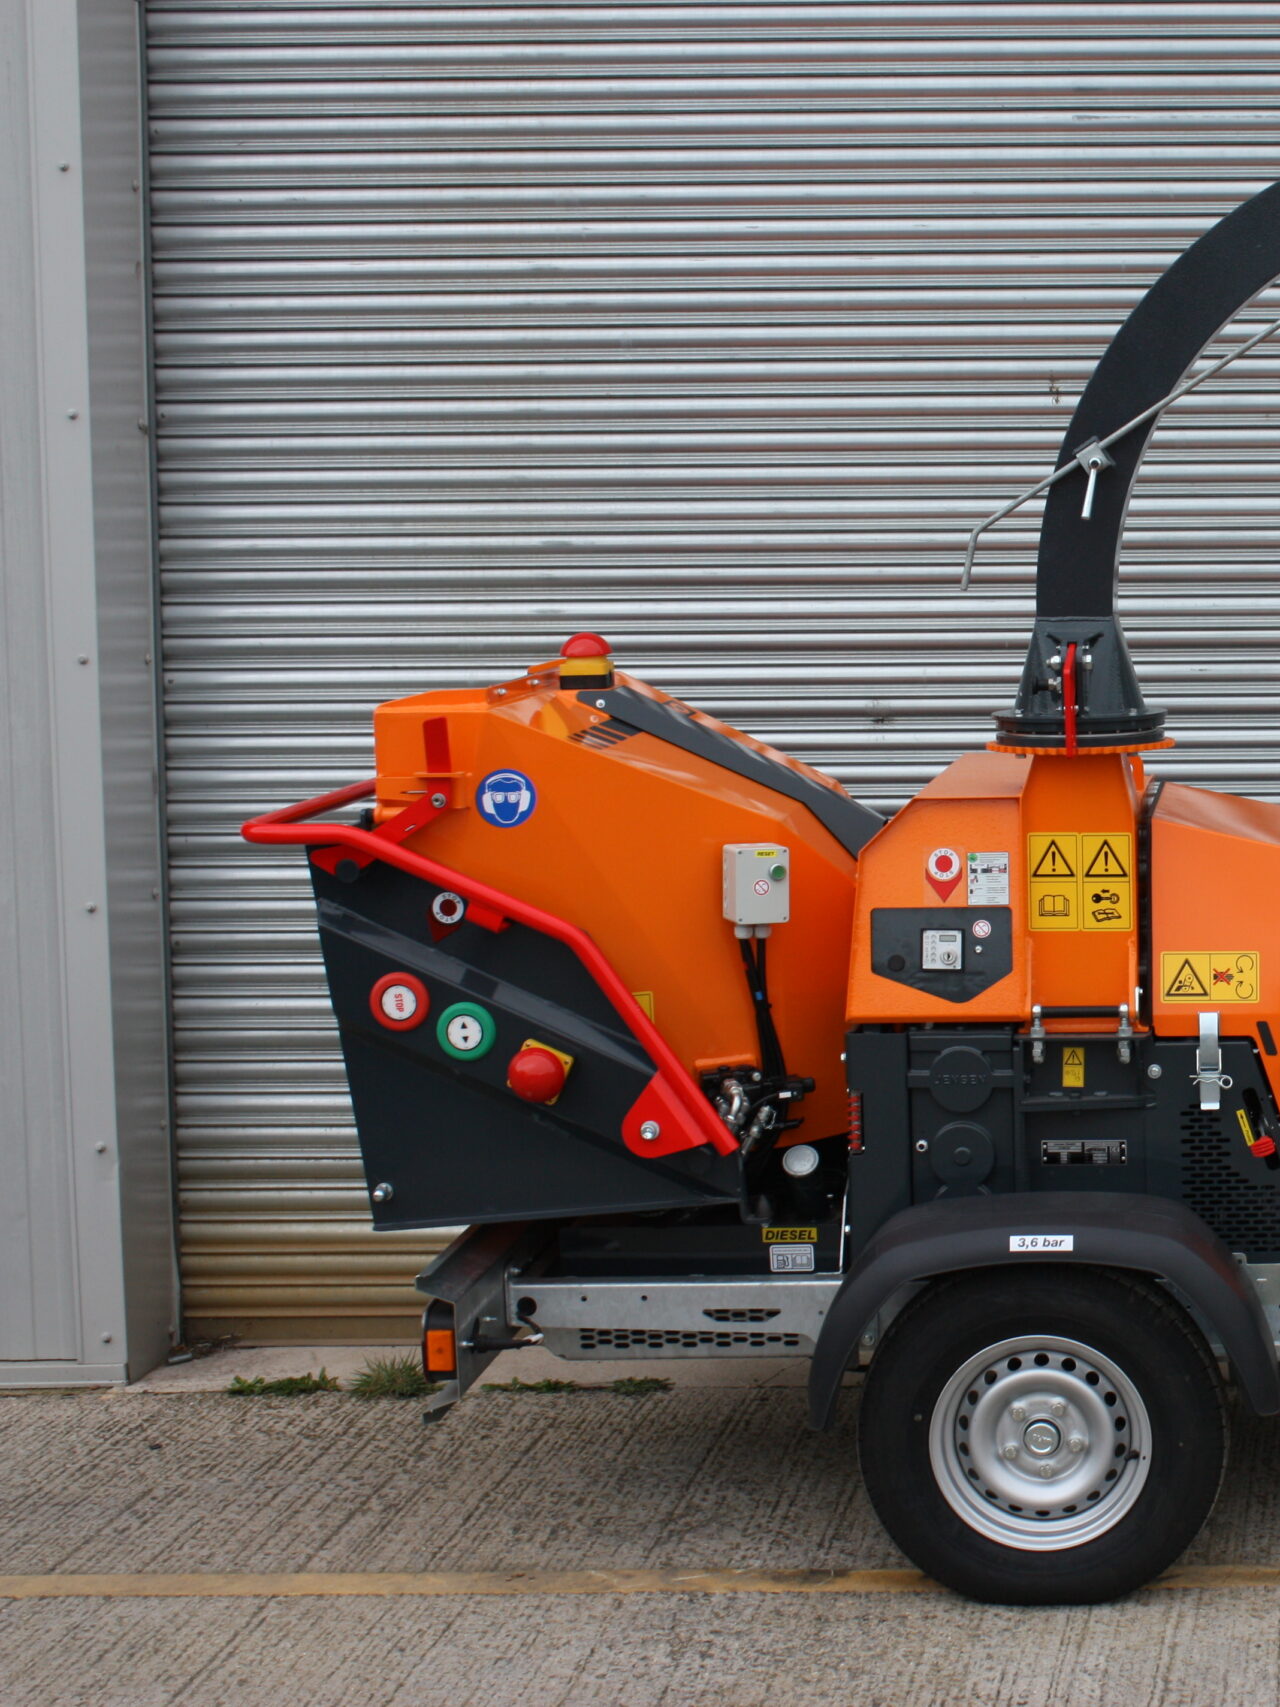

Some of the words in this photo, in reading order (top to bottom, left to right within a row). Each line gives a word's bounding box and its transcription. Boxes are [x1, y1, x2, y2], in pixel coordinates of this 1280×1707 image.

[934, 849, 954, 857] STOP
[933, 870, 954, 878] STOP
[394, 993, 405, 1013] STOP
[765, 1229, 816, 1241] DIESEL
[1017, 1237, 1039, 1249] 3,6
[1042, 1237, 1065, 1248] bar
